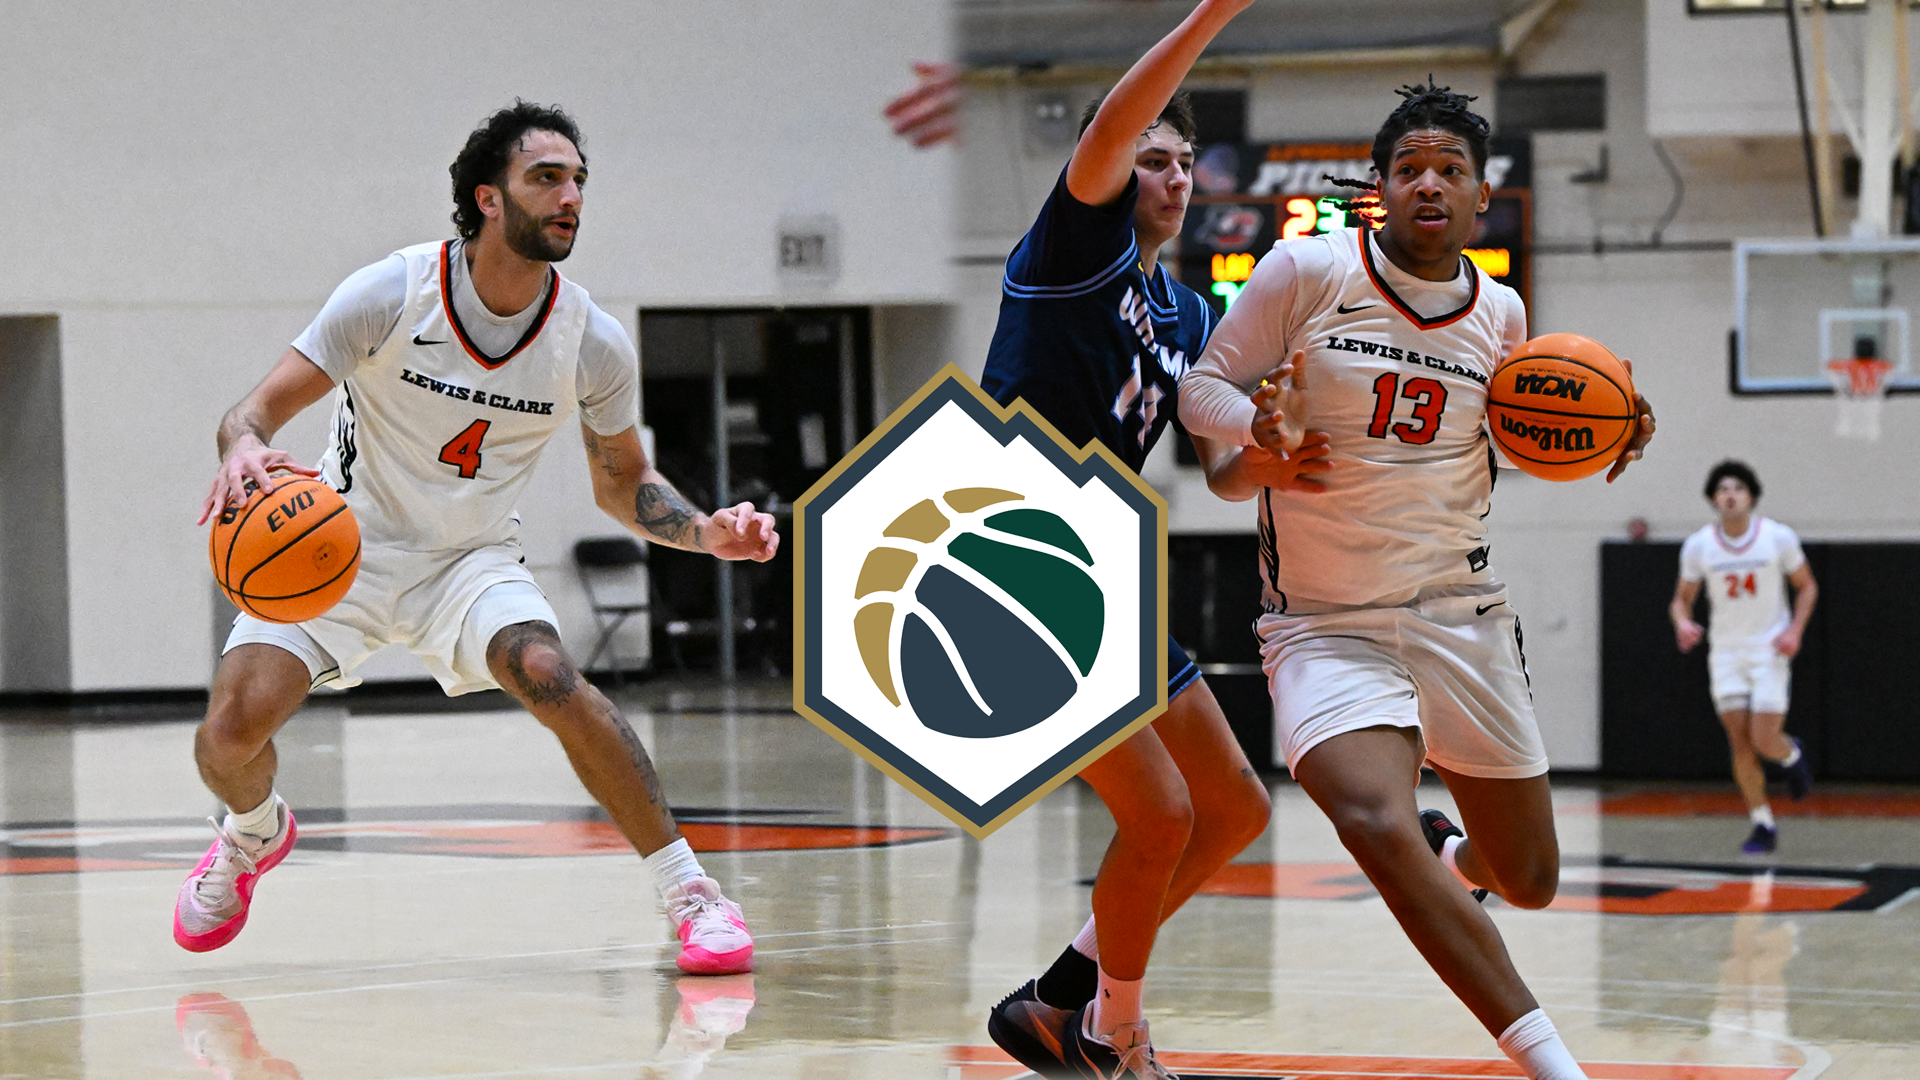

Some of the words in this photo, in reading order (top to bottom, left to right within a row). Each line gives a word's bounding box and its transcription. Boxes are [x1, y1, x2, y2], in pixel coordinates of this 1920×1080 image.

[780, 234, 825, 267] EXIT
[1327, 336, 1403, 361] LEWIS
[1407, 351, 1422, 365] &
[1425, 356, 1488, 385] CLARK
[400, 369, 471, 401] LEWIS
[472, 390, 486, 405] &
[488, 394, 554, 415] CLARK
[1367, 371, 1449, 445] 13
[1515, 373, 1587, 402] NCAA
[438, 418, 492, 479] 4
[1500, 412, 1595, 451] Wilson
[266, 490, 315, 533] EVO
[1724, 572, 1757, 599] 24
